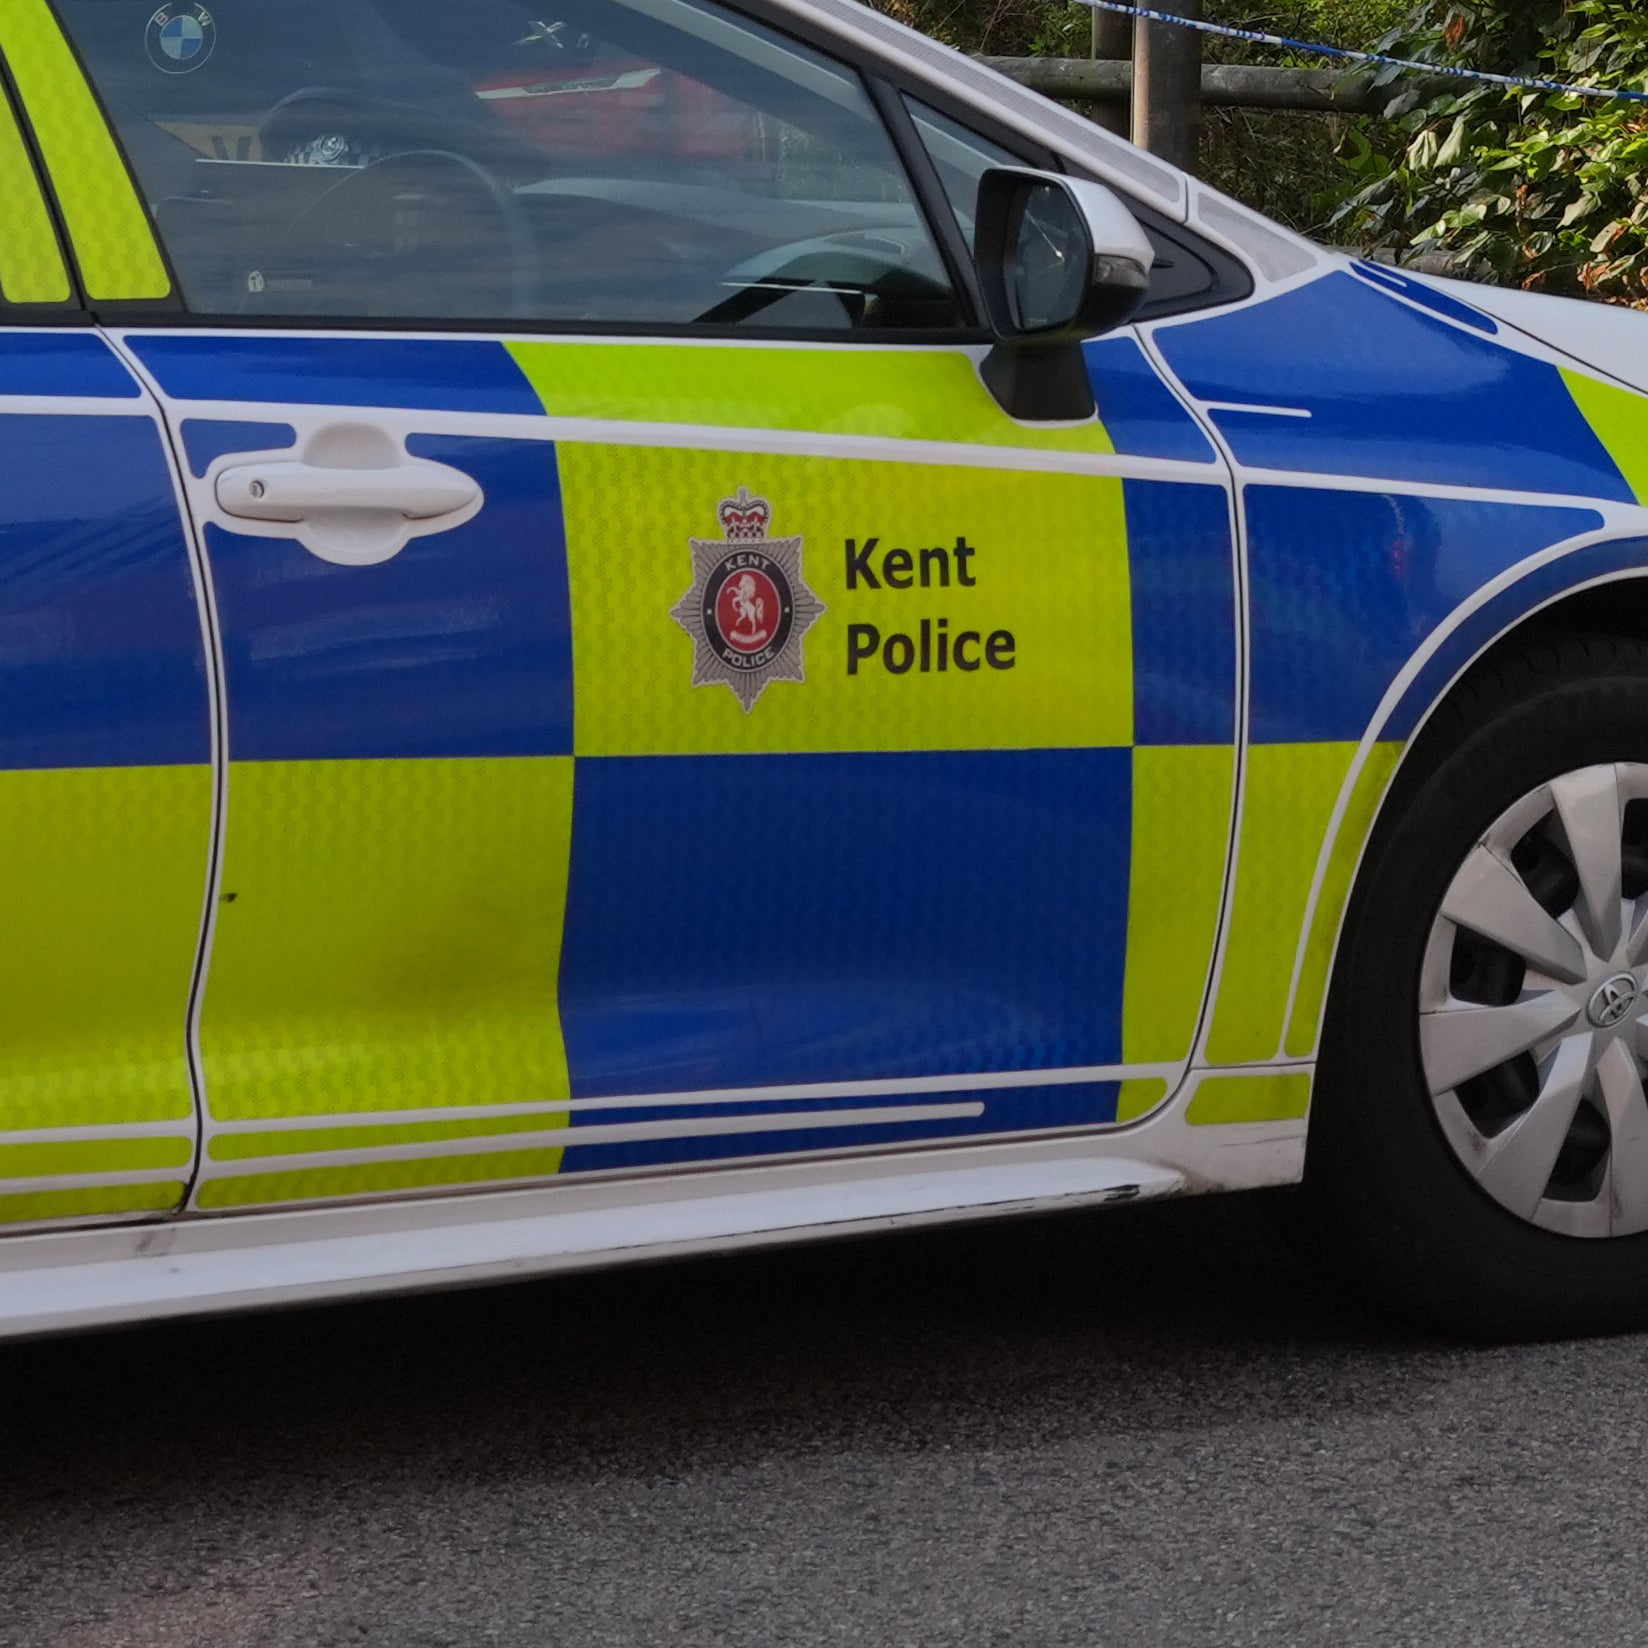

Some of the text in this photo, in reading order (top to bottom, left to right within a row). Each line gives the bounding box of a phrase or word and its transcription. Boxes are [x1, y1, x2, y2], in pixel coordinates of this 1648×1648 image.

[723, 552, 772, 574] KENT
[844, 536, 977, 590] Kent
[721, 644, 778, 669] POLICE
[845, 618, 1017, 676] Police
